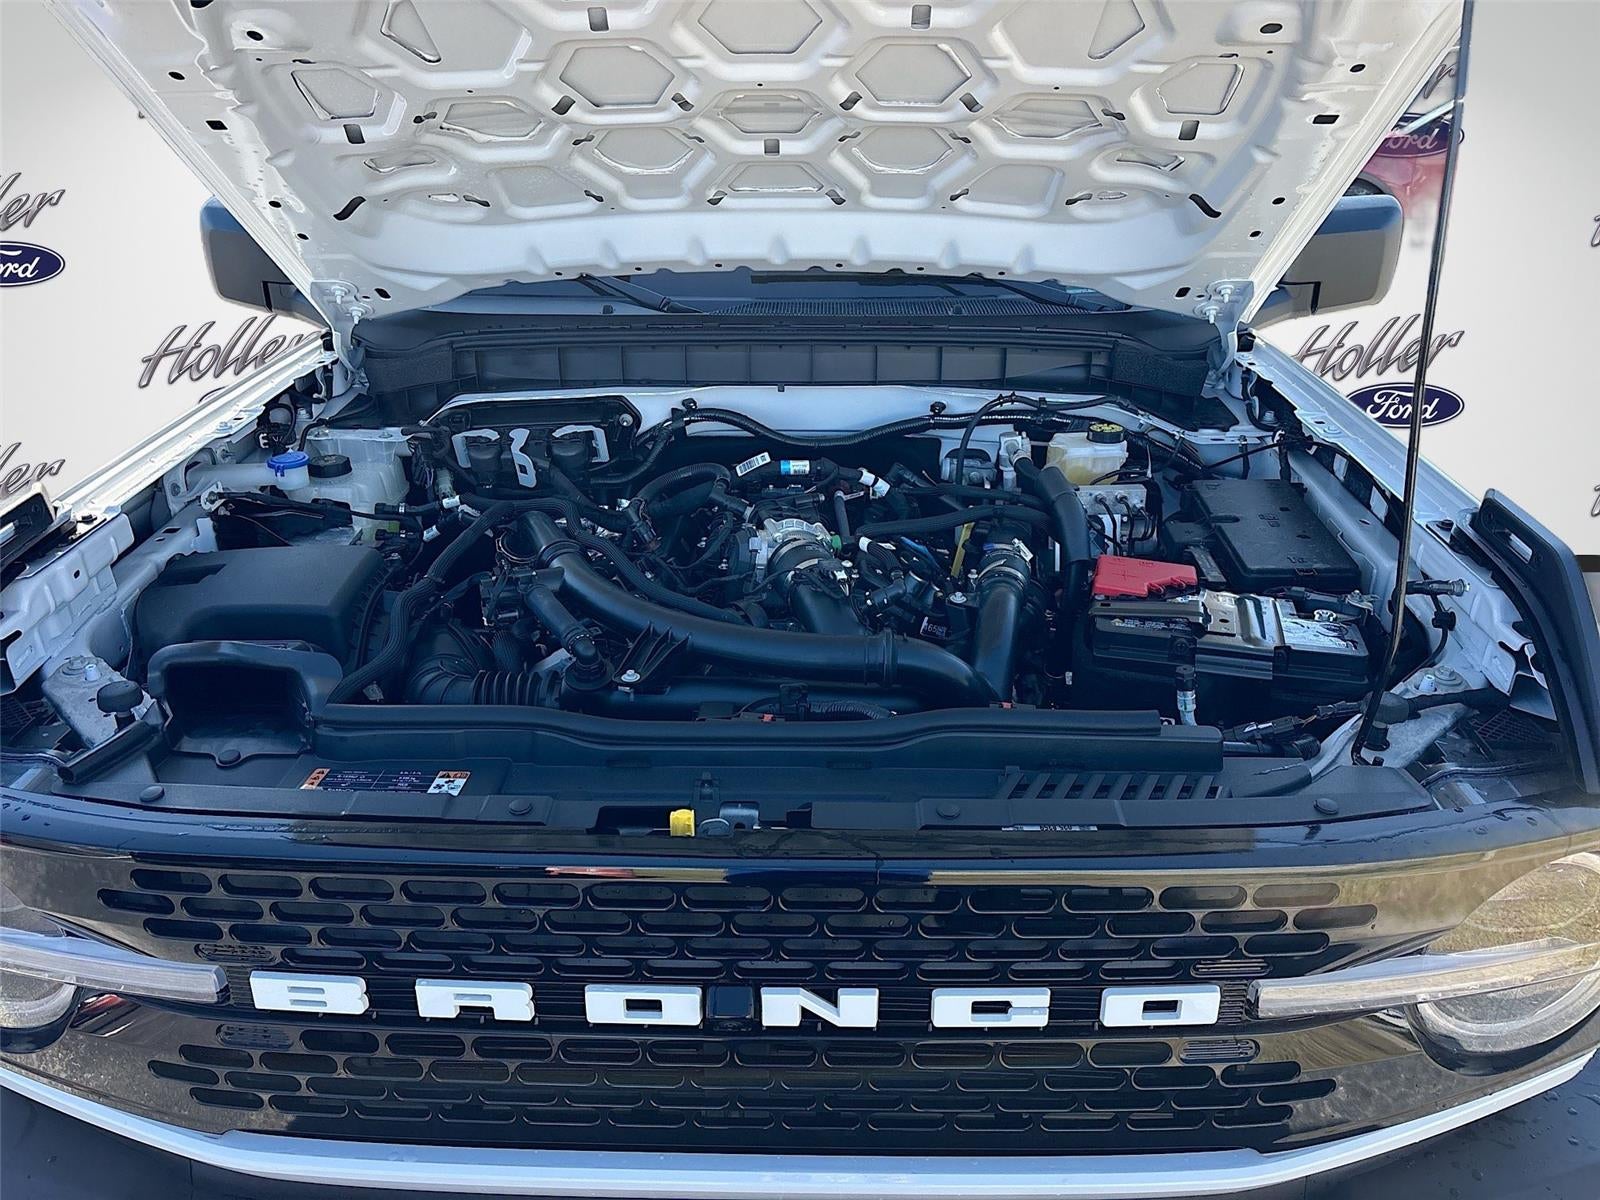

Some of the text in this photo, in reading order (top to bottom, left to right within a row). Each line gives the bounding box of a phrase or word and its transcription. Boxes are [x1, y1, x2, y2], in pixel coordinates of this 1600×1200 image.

[1385, 122, 1440, 150] ord
[1291, 313, 1465, 382] Holler
[250, 970, 1221, 1027] BRONCO
